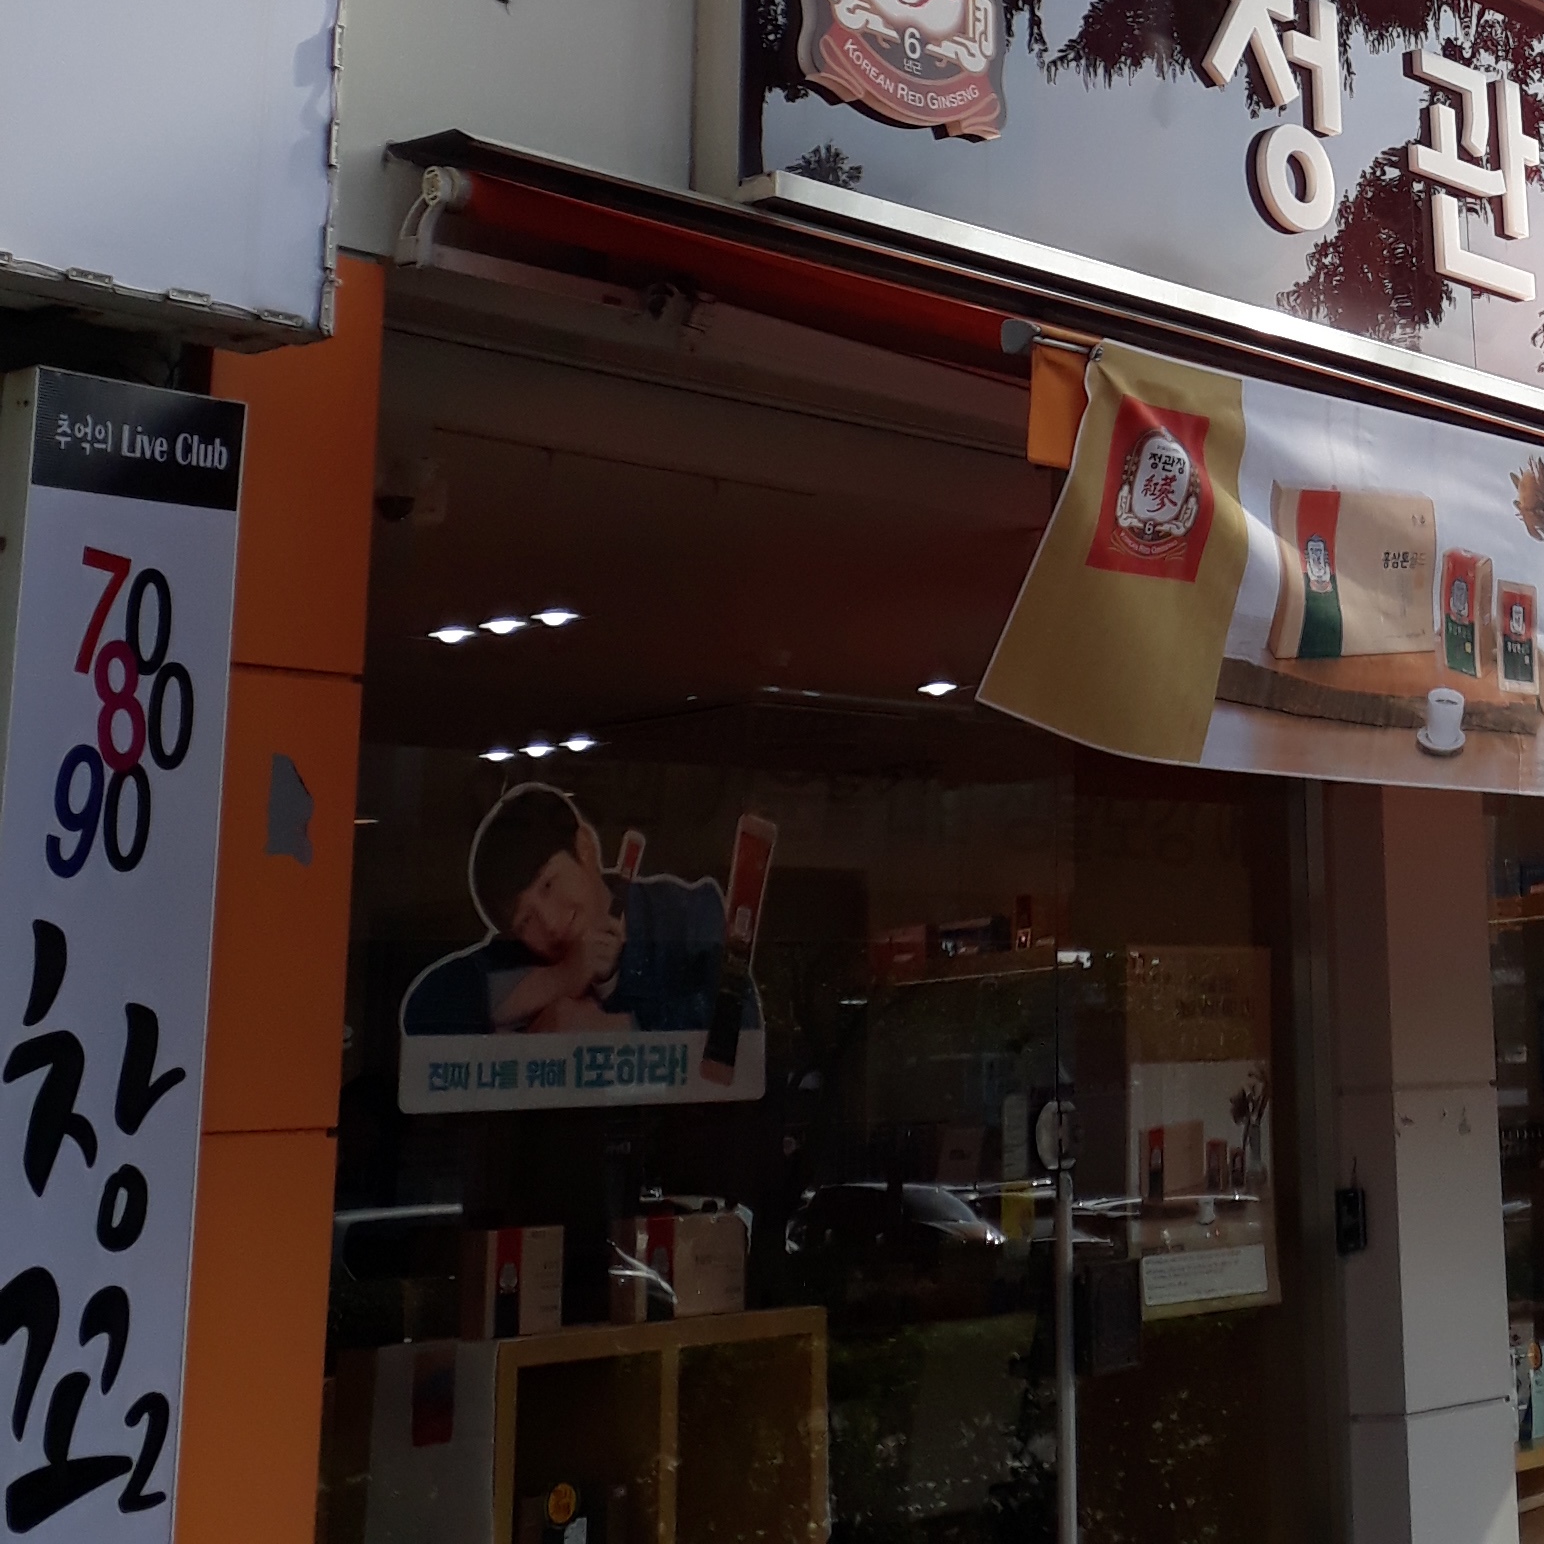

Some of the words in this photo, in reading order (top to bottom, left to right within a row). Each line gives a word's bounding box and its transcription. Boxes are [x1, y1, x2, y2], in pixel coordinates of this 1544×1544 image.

[843, 38, 895, 94] KOREAN
[896, 83, 925, 108] RED
[926, 84, 981, 110] GINSENG
[903, 27, 921, 59] 6
[55, 413, 112, 454] 추억의
[121, 423, 168, 463] Live
[175, 432, 229, 470] Club
[1148, 452, 1187, 475] 정관장
[75, 546, 172, 676] 70
[95, 640, 194, 772] 80
[46, 744, 151, 878] 90
[429, 1061, 470, 1091] 진짜
[477, 1059, 518, 1090] 나를
[526, 1057, 566, 1087] 위해
